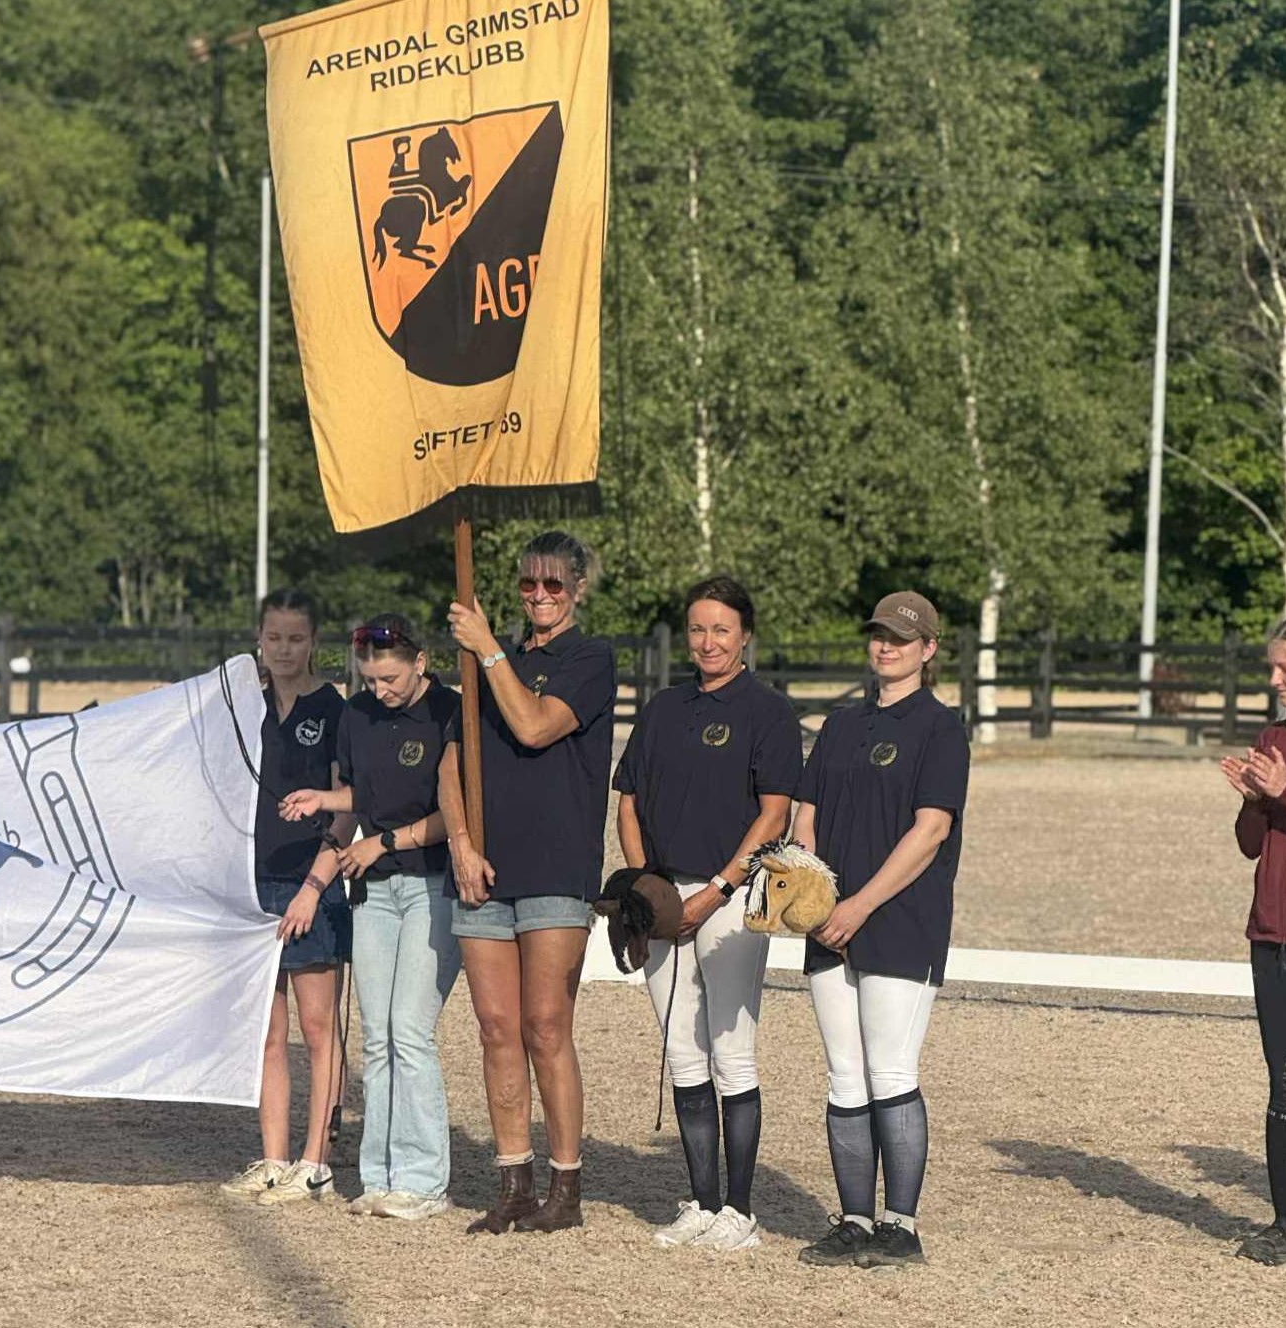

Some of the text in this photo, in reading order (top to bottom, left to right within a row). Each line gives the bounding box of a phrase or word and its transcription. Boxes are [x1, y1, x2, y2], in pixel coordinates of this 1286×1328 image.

[306, 0, 580, 79] ARENDAL GRIMSTAD
[370, 40, 525, 92] RIDEKLUBB
[413, 420, 495, 461] SIFTET
